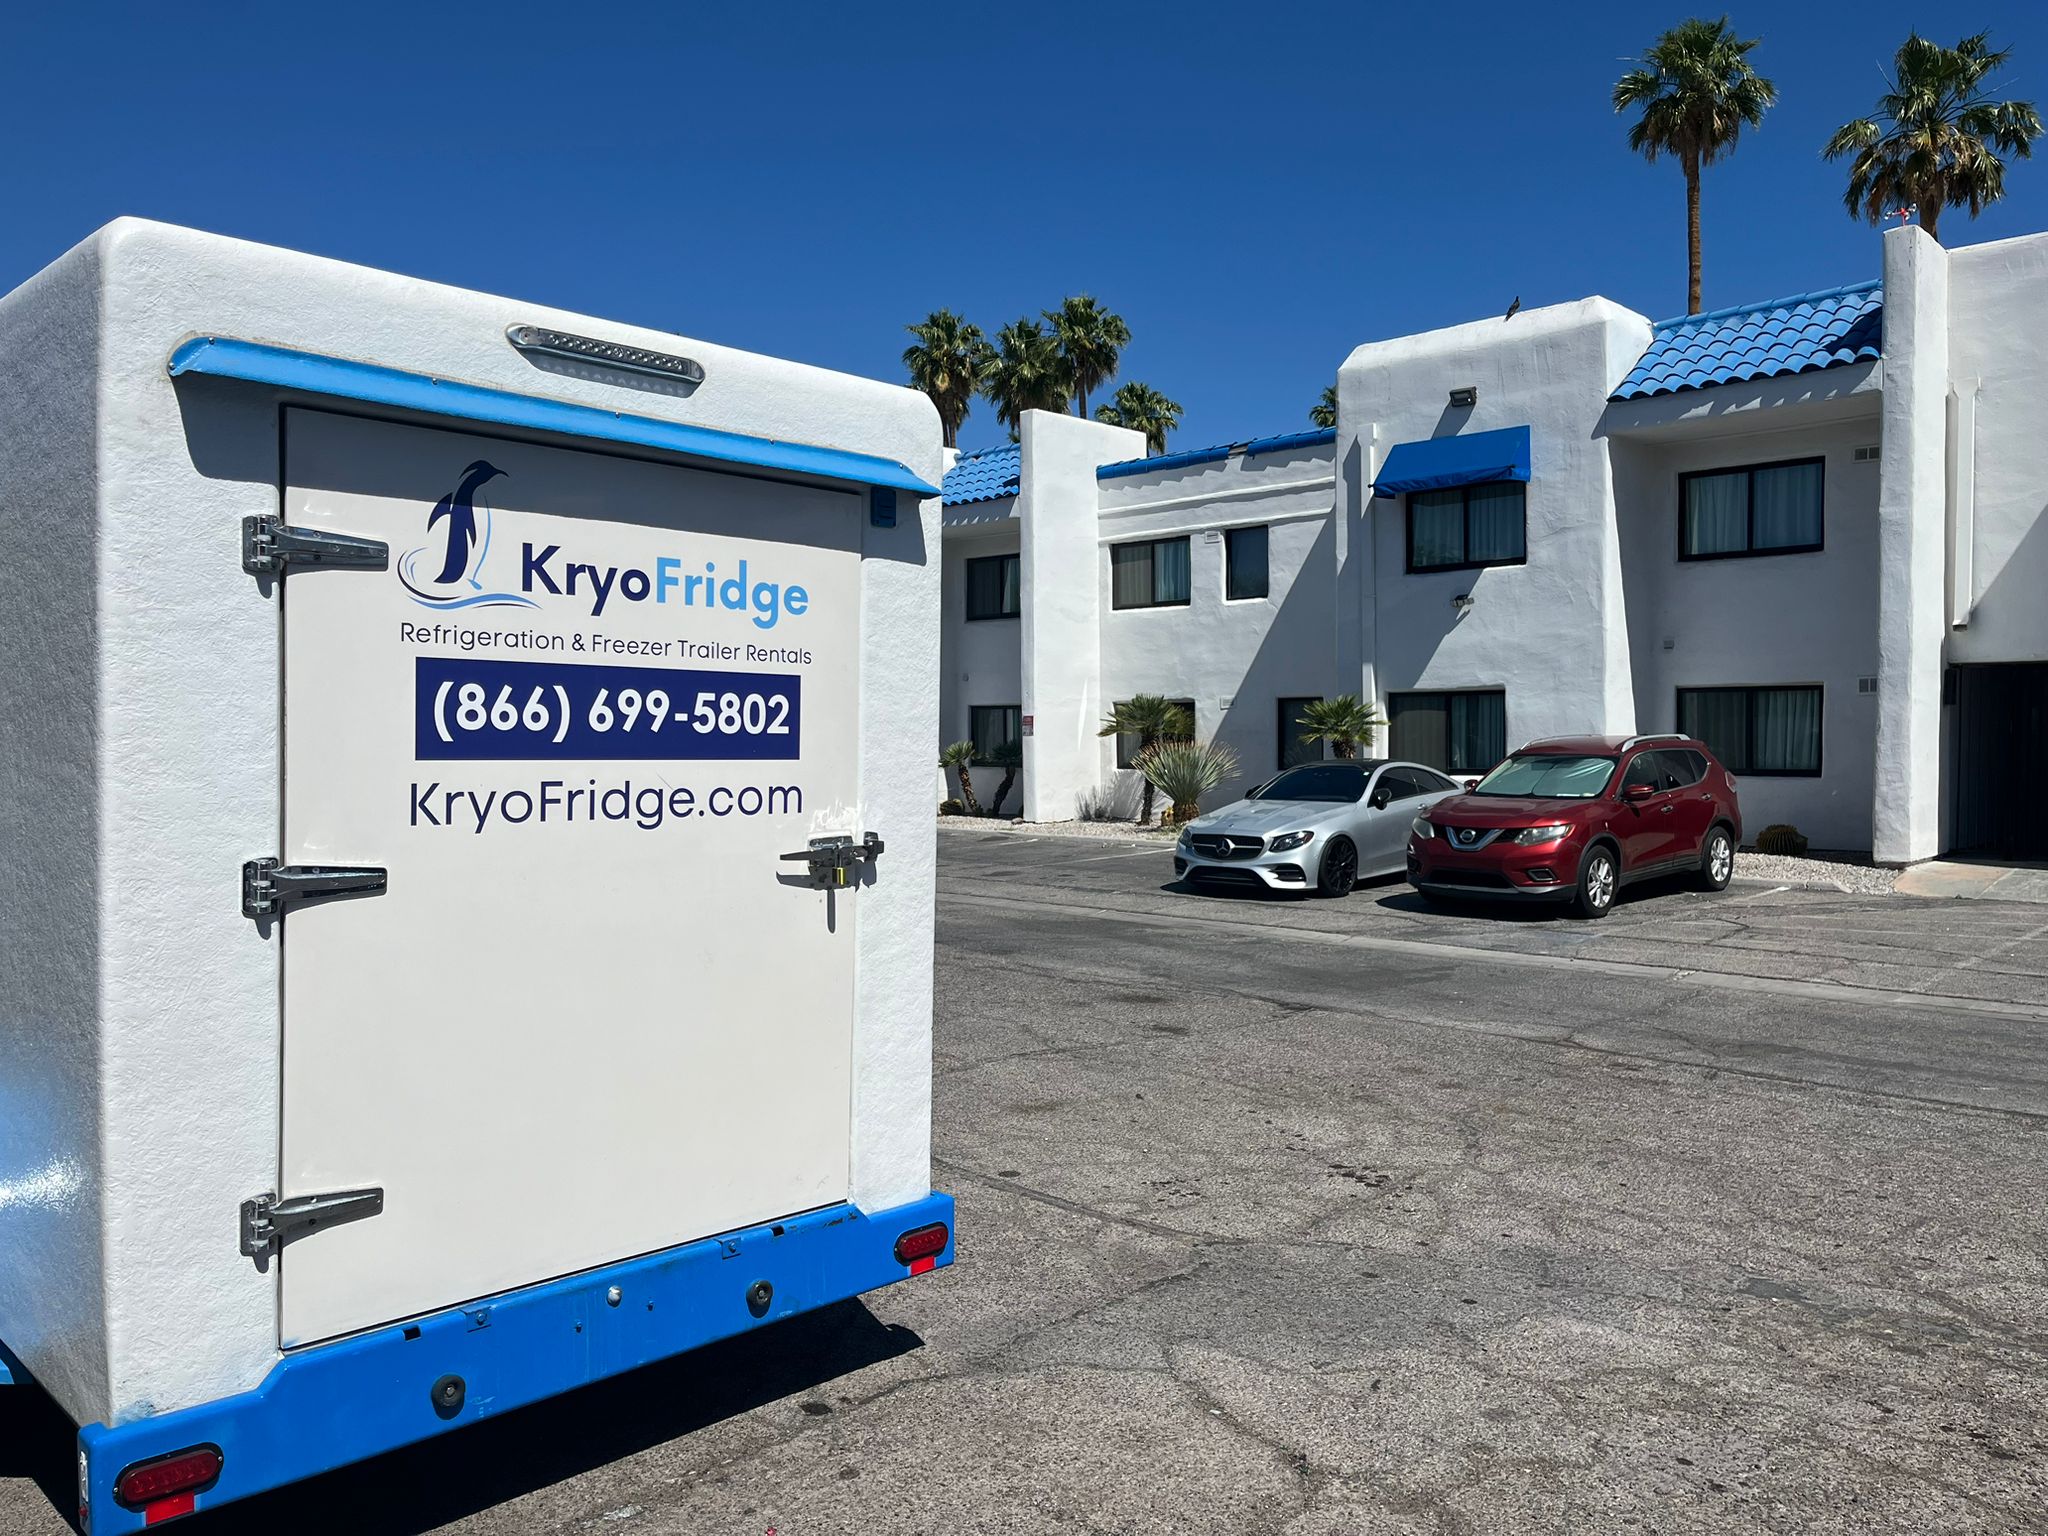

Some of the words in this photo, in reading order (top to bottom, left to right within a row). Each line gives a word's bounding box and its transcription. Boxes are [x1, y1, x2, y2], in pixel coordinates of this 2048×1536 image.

[521, 541, 810, 630] KryoFridge
[400, 622, 565, 651] Refrigeration
[571, 633, 587, 652] &
[592, 634, 673, 657] Freezer
[677, 639, 741, 661] Trailer
[746, 644, 812, 665] Rentals
[434, 681, 571, 743] (866)
[588, 687, 790, 735] 699-5802
[410, 778, 803, 835] KryoFridge.com
